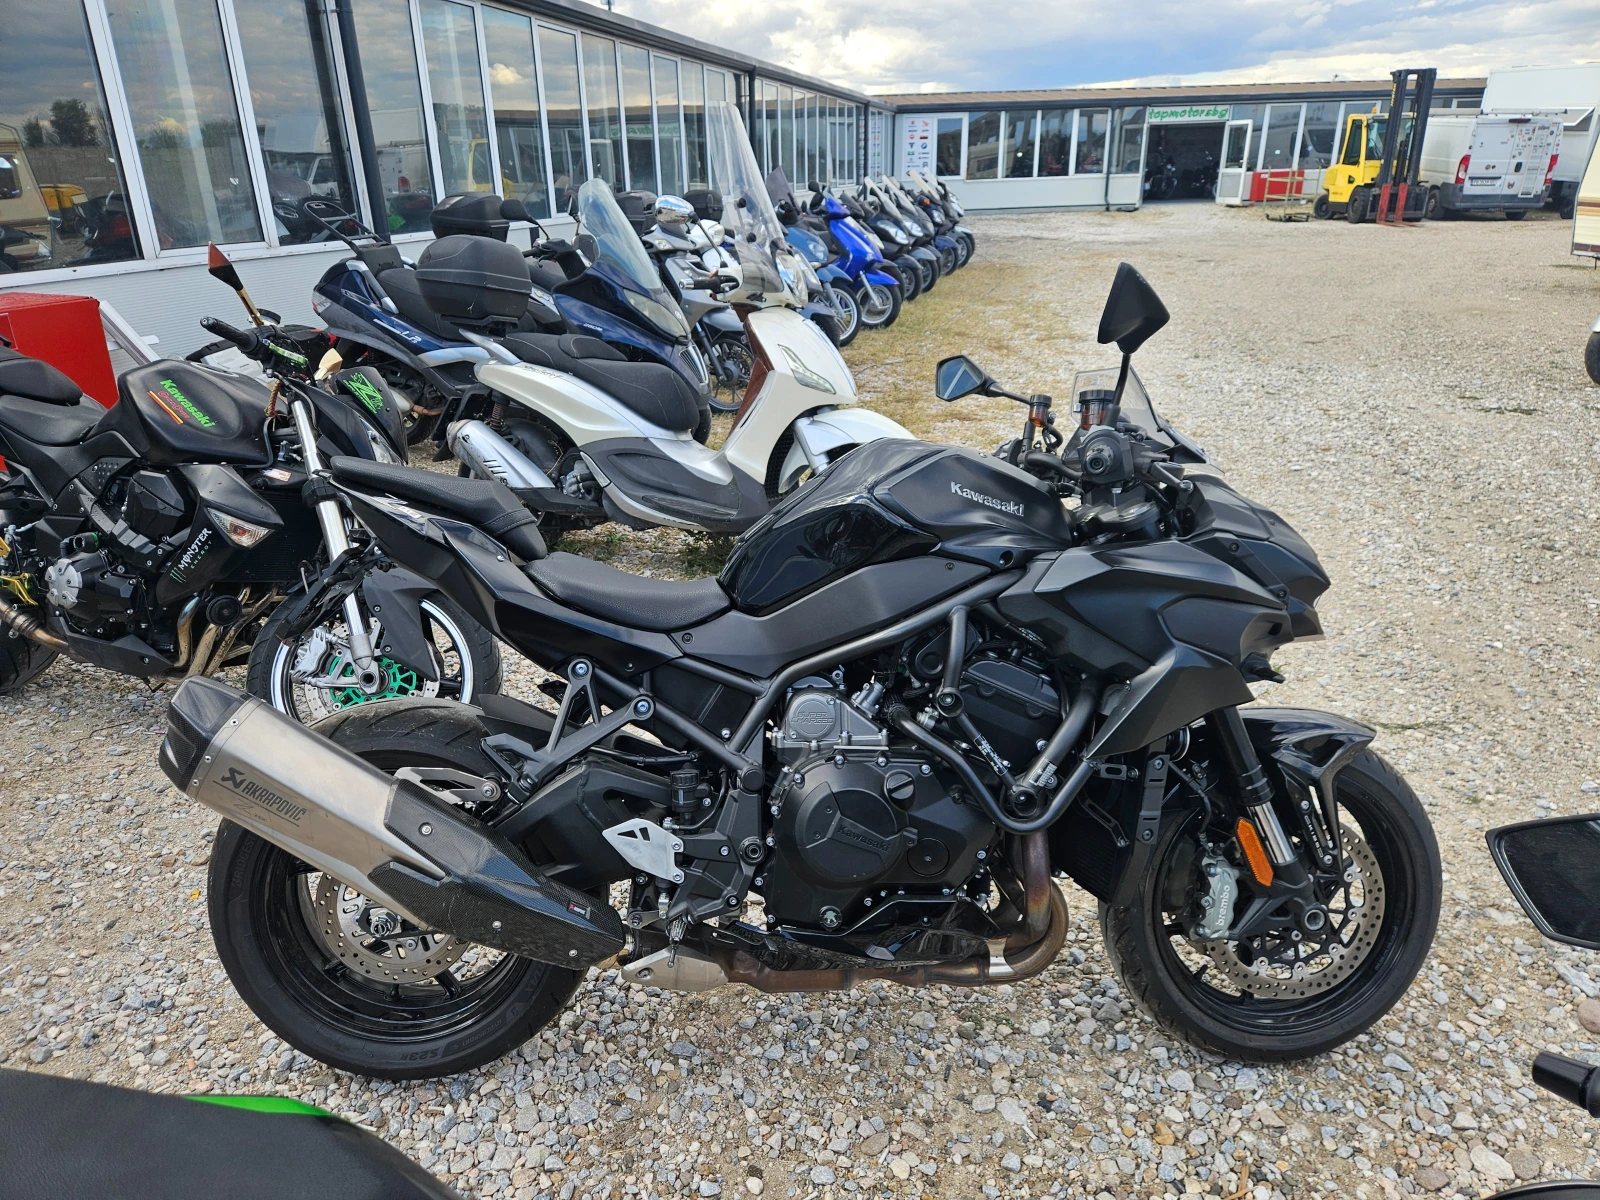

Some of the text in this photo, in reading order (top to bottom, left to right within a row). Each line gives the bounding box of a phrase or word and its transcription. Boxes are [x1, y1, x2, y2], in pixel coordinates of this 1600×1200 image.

[1149, 105, 1229, 121] topmotorsbg
[159, 379, 217, 428] Kawasaki
[950, 481, 1025, 517] Kawasaki
[177, 527, 213, 571] MONSTER
[190, 540, 212, 569] ENERGY
[837, 823, 892, 852] Kawasaki
[230, 831, 259, 888] BRIDGEST
[1215, 884, 1231, 926] brembo
